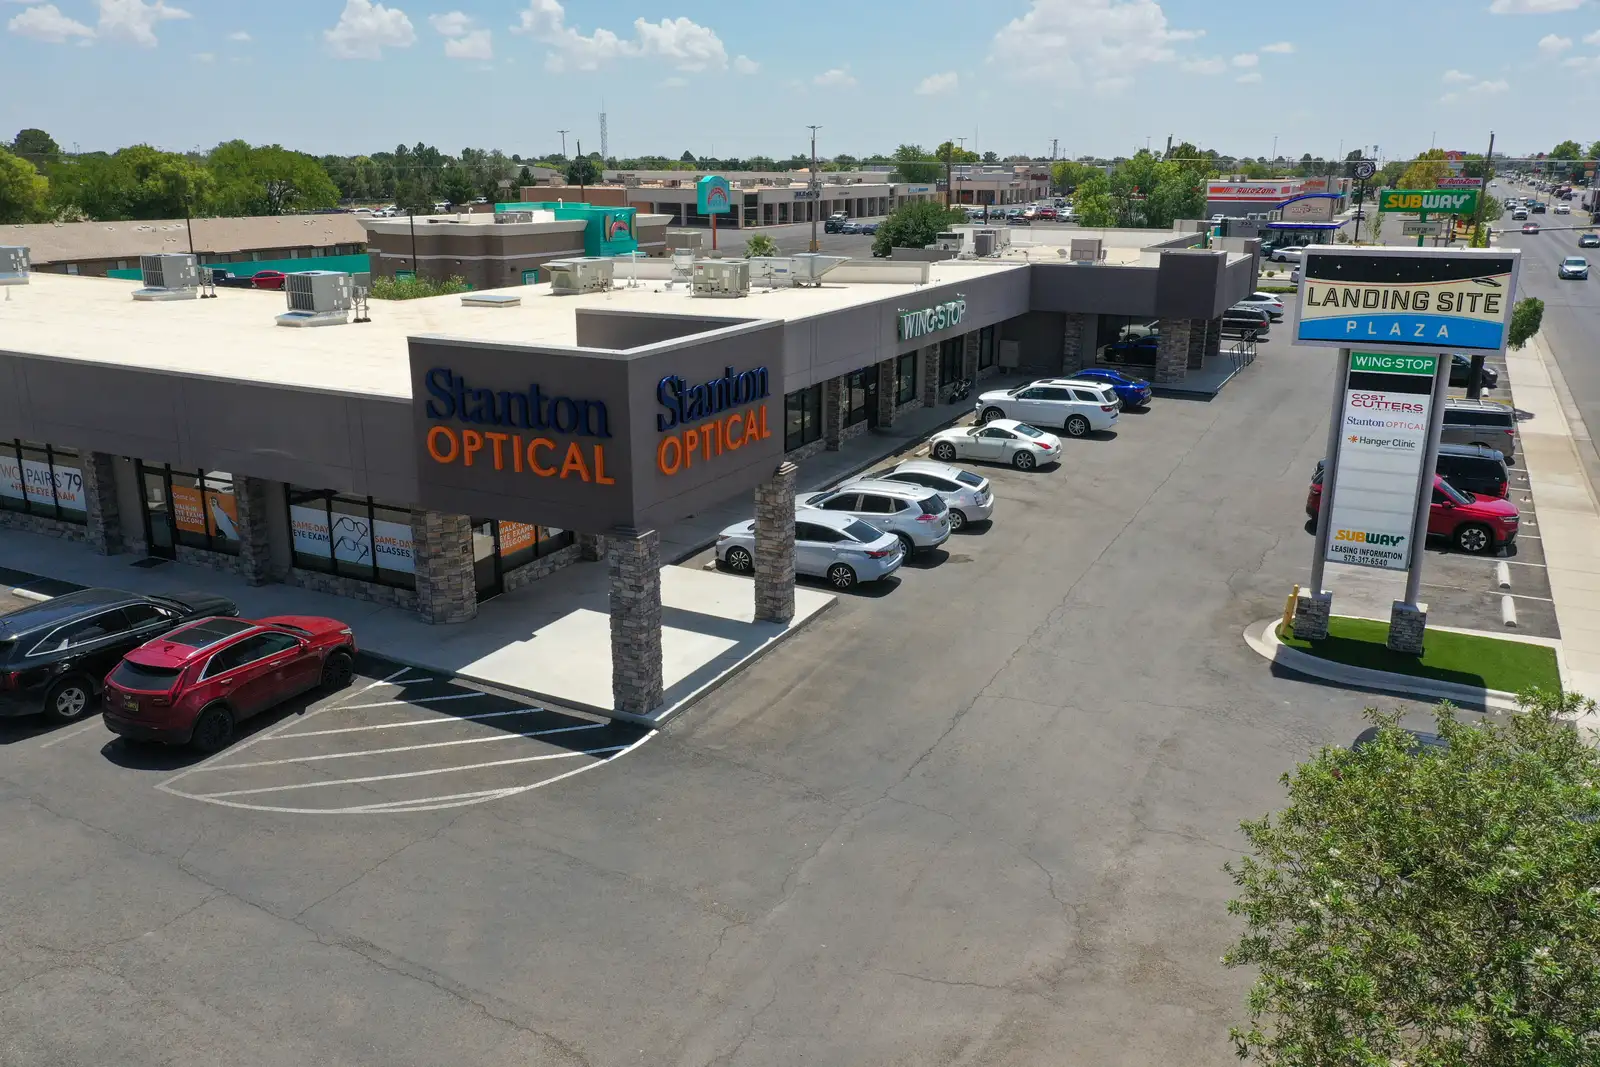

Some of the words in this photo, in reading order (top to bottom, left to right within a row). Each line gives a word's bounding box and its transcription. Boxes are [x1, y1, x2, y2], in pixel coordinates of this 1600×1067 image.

[1384, 194, 1471, 209] SUBWAY
[1307, 286, 1430, 311] LANDING
[1436, 291, 1502, 314] SITE
[1346, 320, 1449, 338] PLAZA
[424, 367, 613, 439] Stanton
[657, 365, 771, 432] Stanton
[1351, 393, 1386, 401] COST
[1351, 400, 1424, 412] CUTTERS
[1346, 415, 1386, 428] Stanton
[1386, 421, 1425, 431] OPTICAL
[657, 404, 771, 476] OPTICAL
[1359, 436, 1391, 447] Hanger
[1392, 438, 1416, 448] Clinic
[426, 425, 615, 485] OPTICAL
[26, 468, 62, 488] PAIRS
[36, 486, 49, 497] EYE
[176, 515, 204, 525] WELCOME
[292, 520, 329, 533] SAME-DAY
[293, 528, 306, 539] EYE
[500, 533, 511, 542] EYE
[513, 524, 533, 536] EXAMS
[500, 532, 531, 549] WELCOME
[1335, 529, 1405, 547] SUBWAY
[374, 535, 414, 548] SAME-DAY
[375, 544, 413, 558] GLASSES.
[1331, 544, 1358, 555] LEASING
[1360, 548, 1403, 560] INFORMATION
[1343, 554, 1388, 567] 575-317-6540
